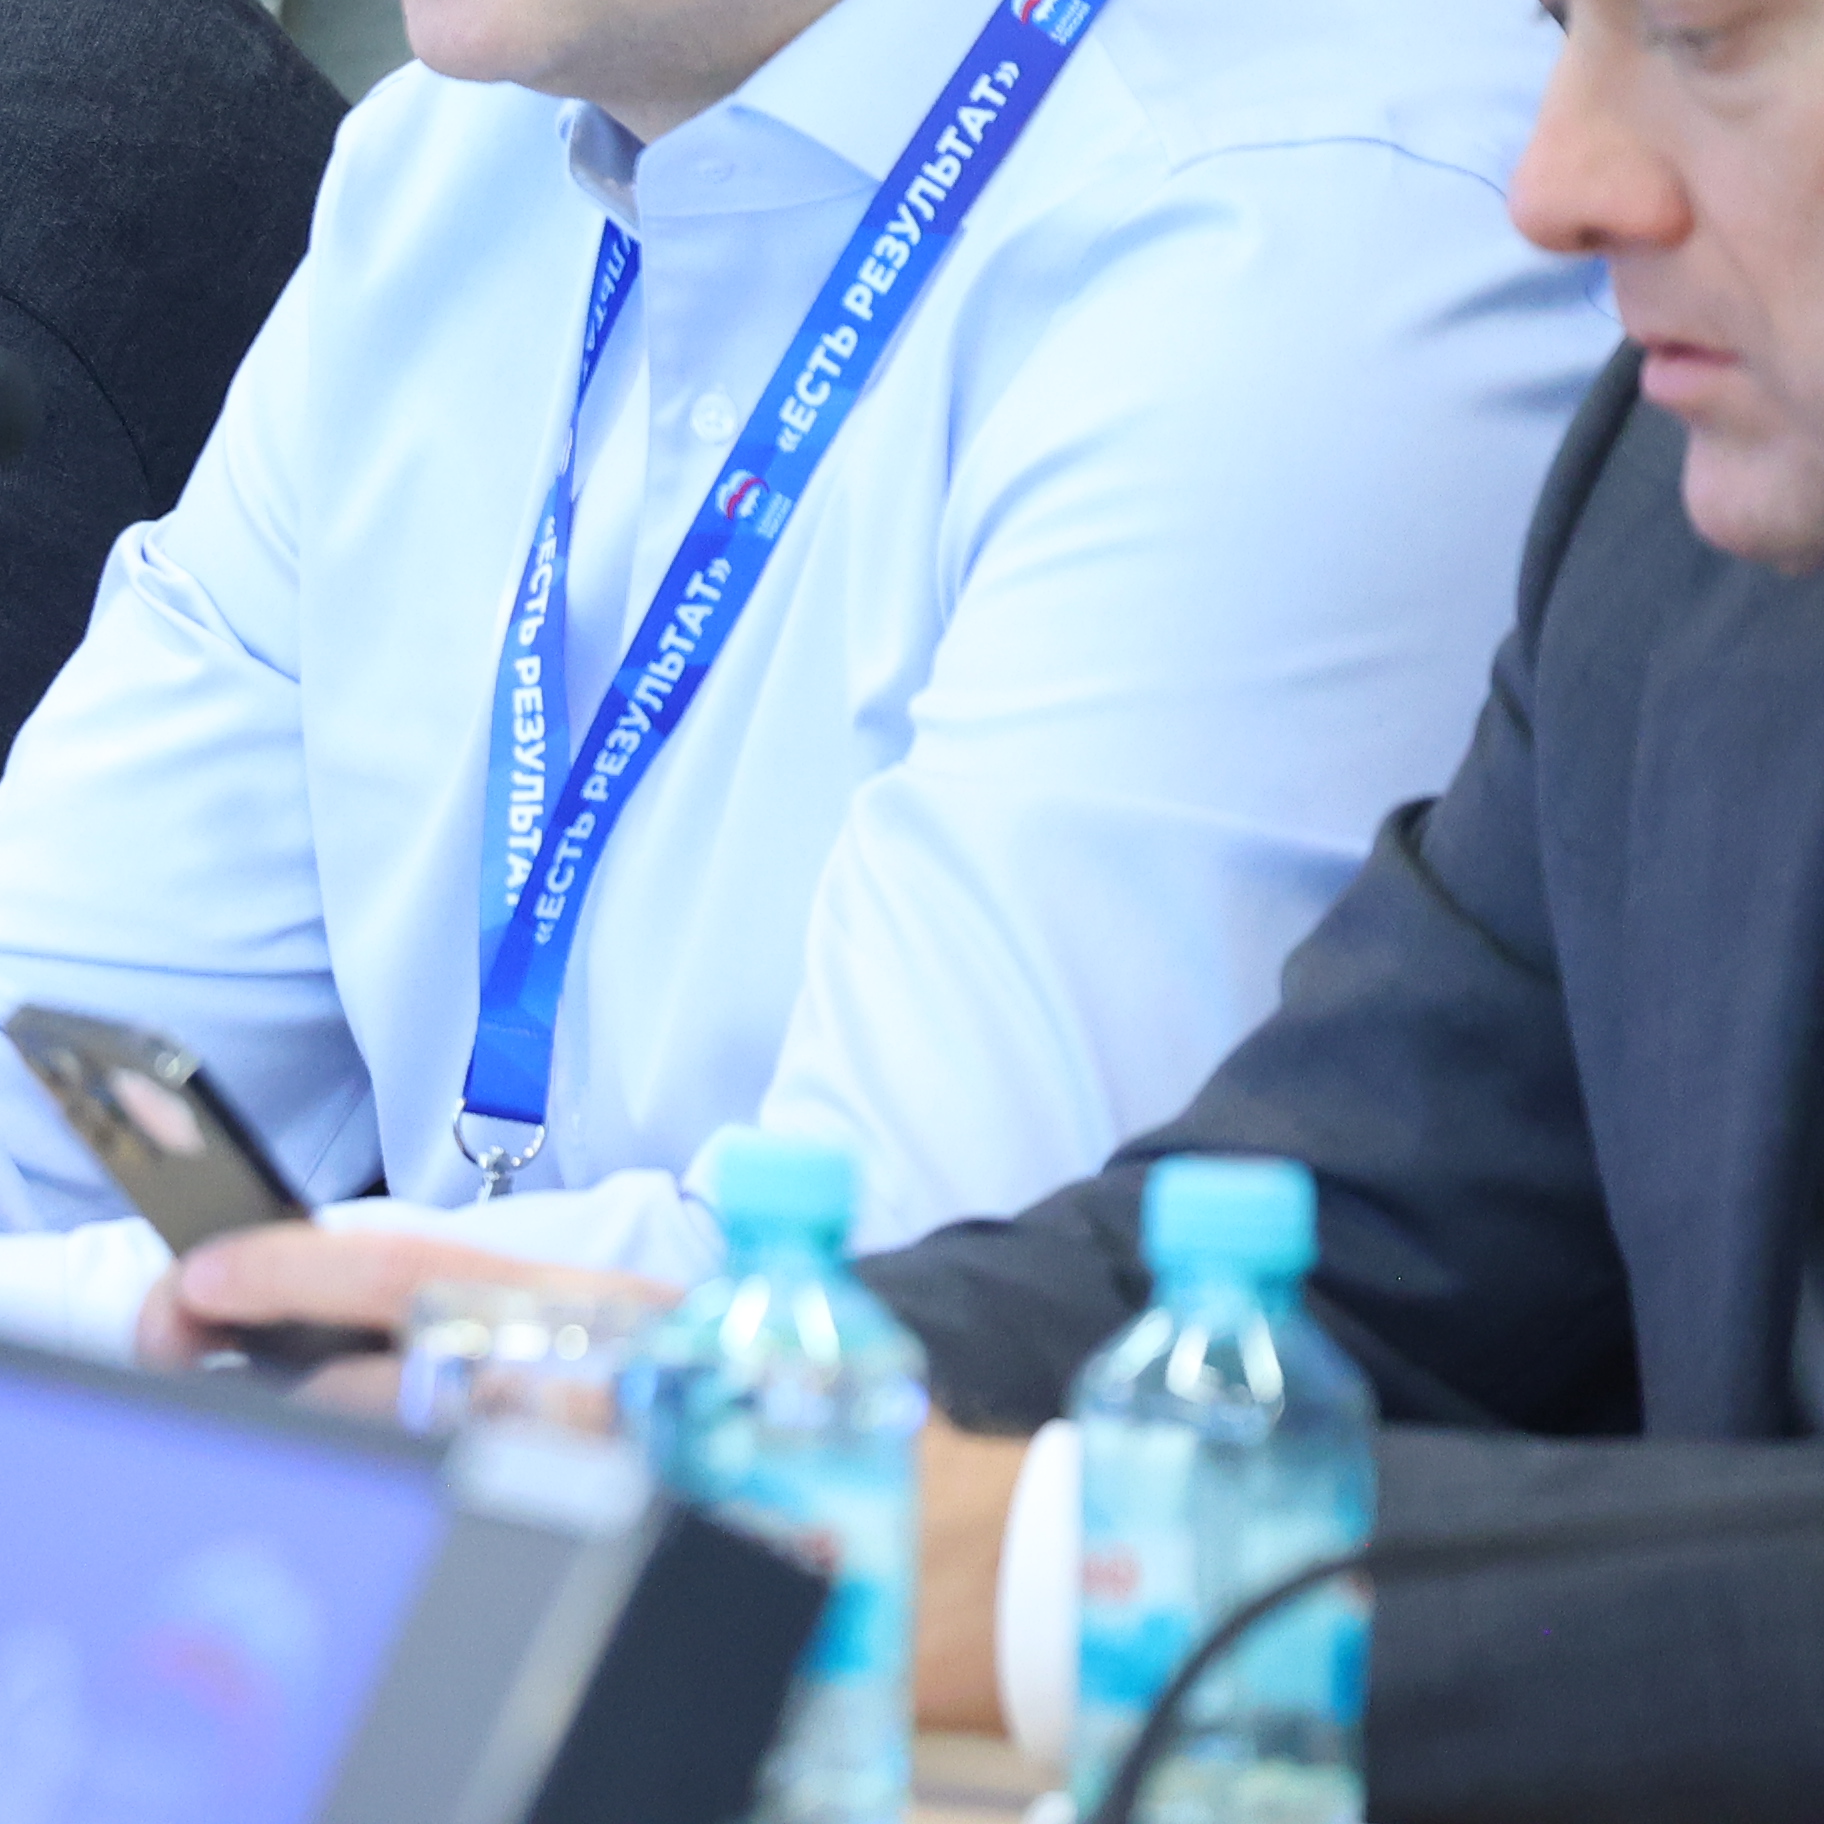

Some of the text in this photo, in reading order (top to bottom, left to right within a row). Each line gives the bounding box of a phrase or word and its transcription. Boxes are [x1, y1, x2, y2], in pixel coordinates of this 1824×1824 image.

[776, 59, 1022, 455] «ЕСТЬ РЕЗУЛЬТАТ»
[533, 557, 734, 946] «ЕСТЬ РЕЗУЛЬТАТ»
